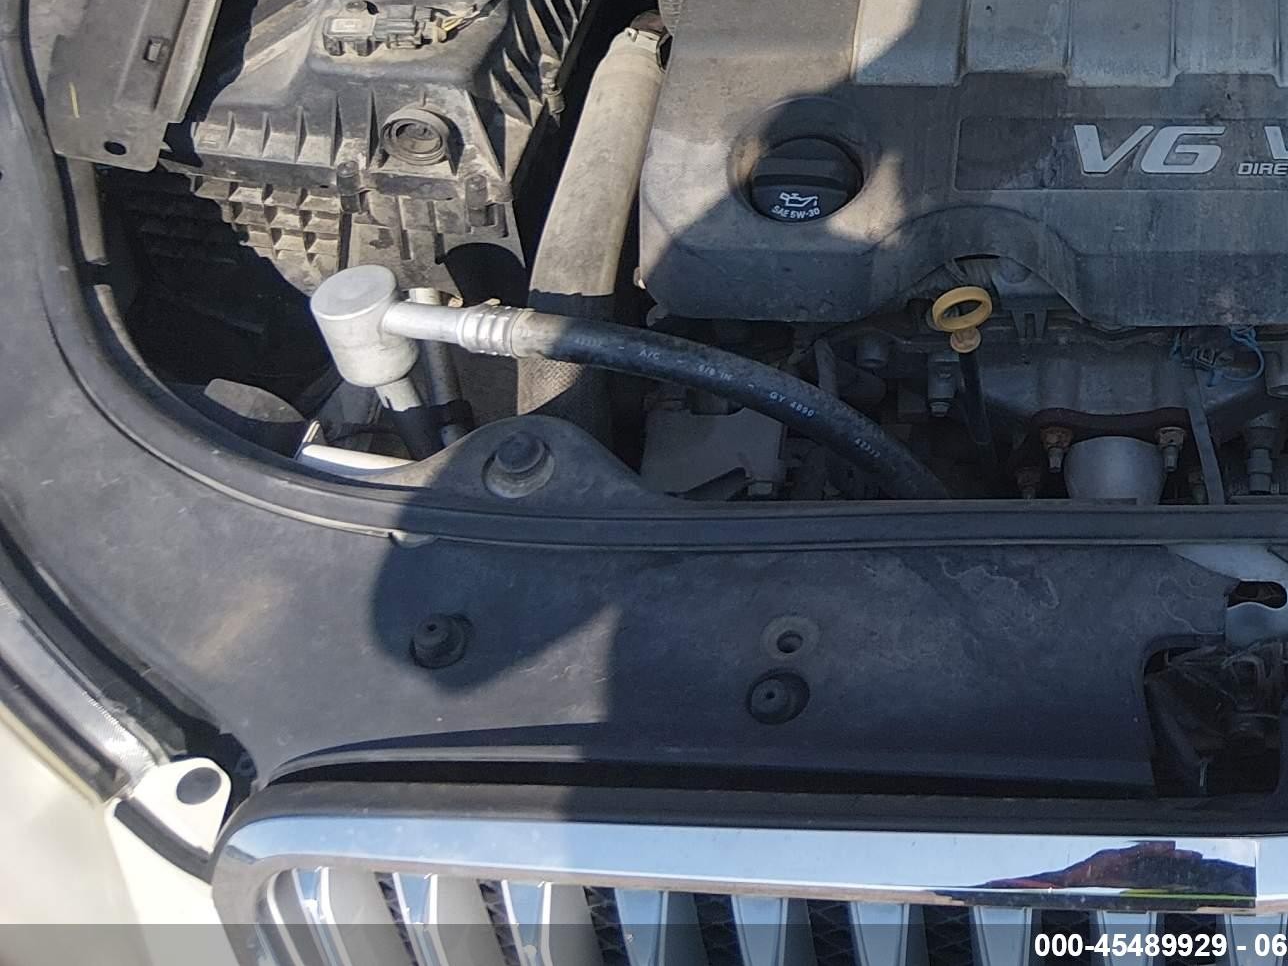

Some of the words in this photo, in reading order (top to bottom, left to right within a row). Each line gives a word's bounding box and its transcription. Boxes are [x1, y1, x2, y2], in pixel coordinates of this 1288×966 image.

[1073, 124, 1226, 175] V6
[771, 205, 790, 218] SAE
[790, 207, 821, 219] 5W-30
